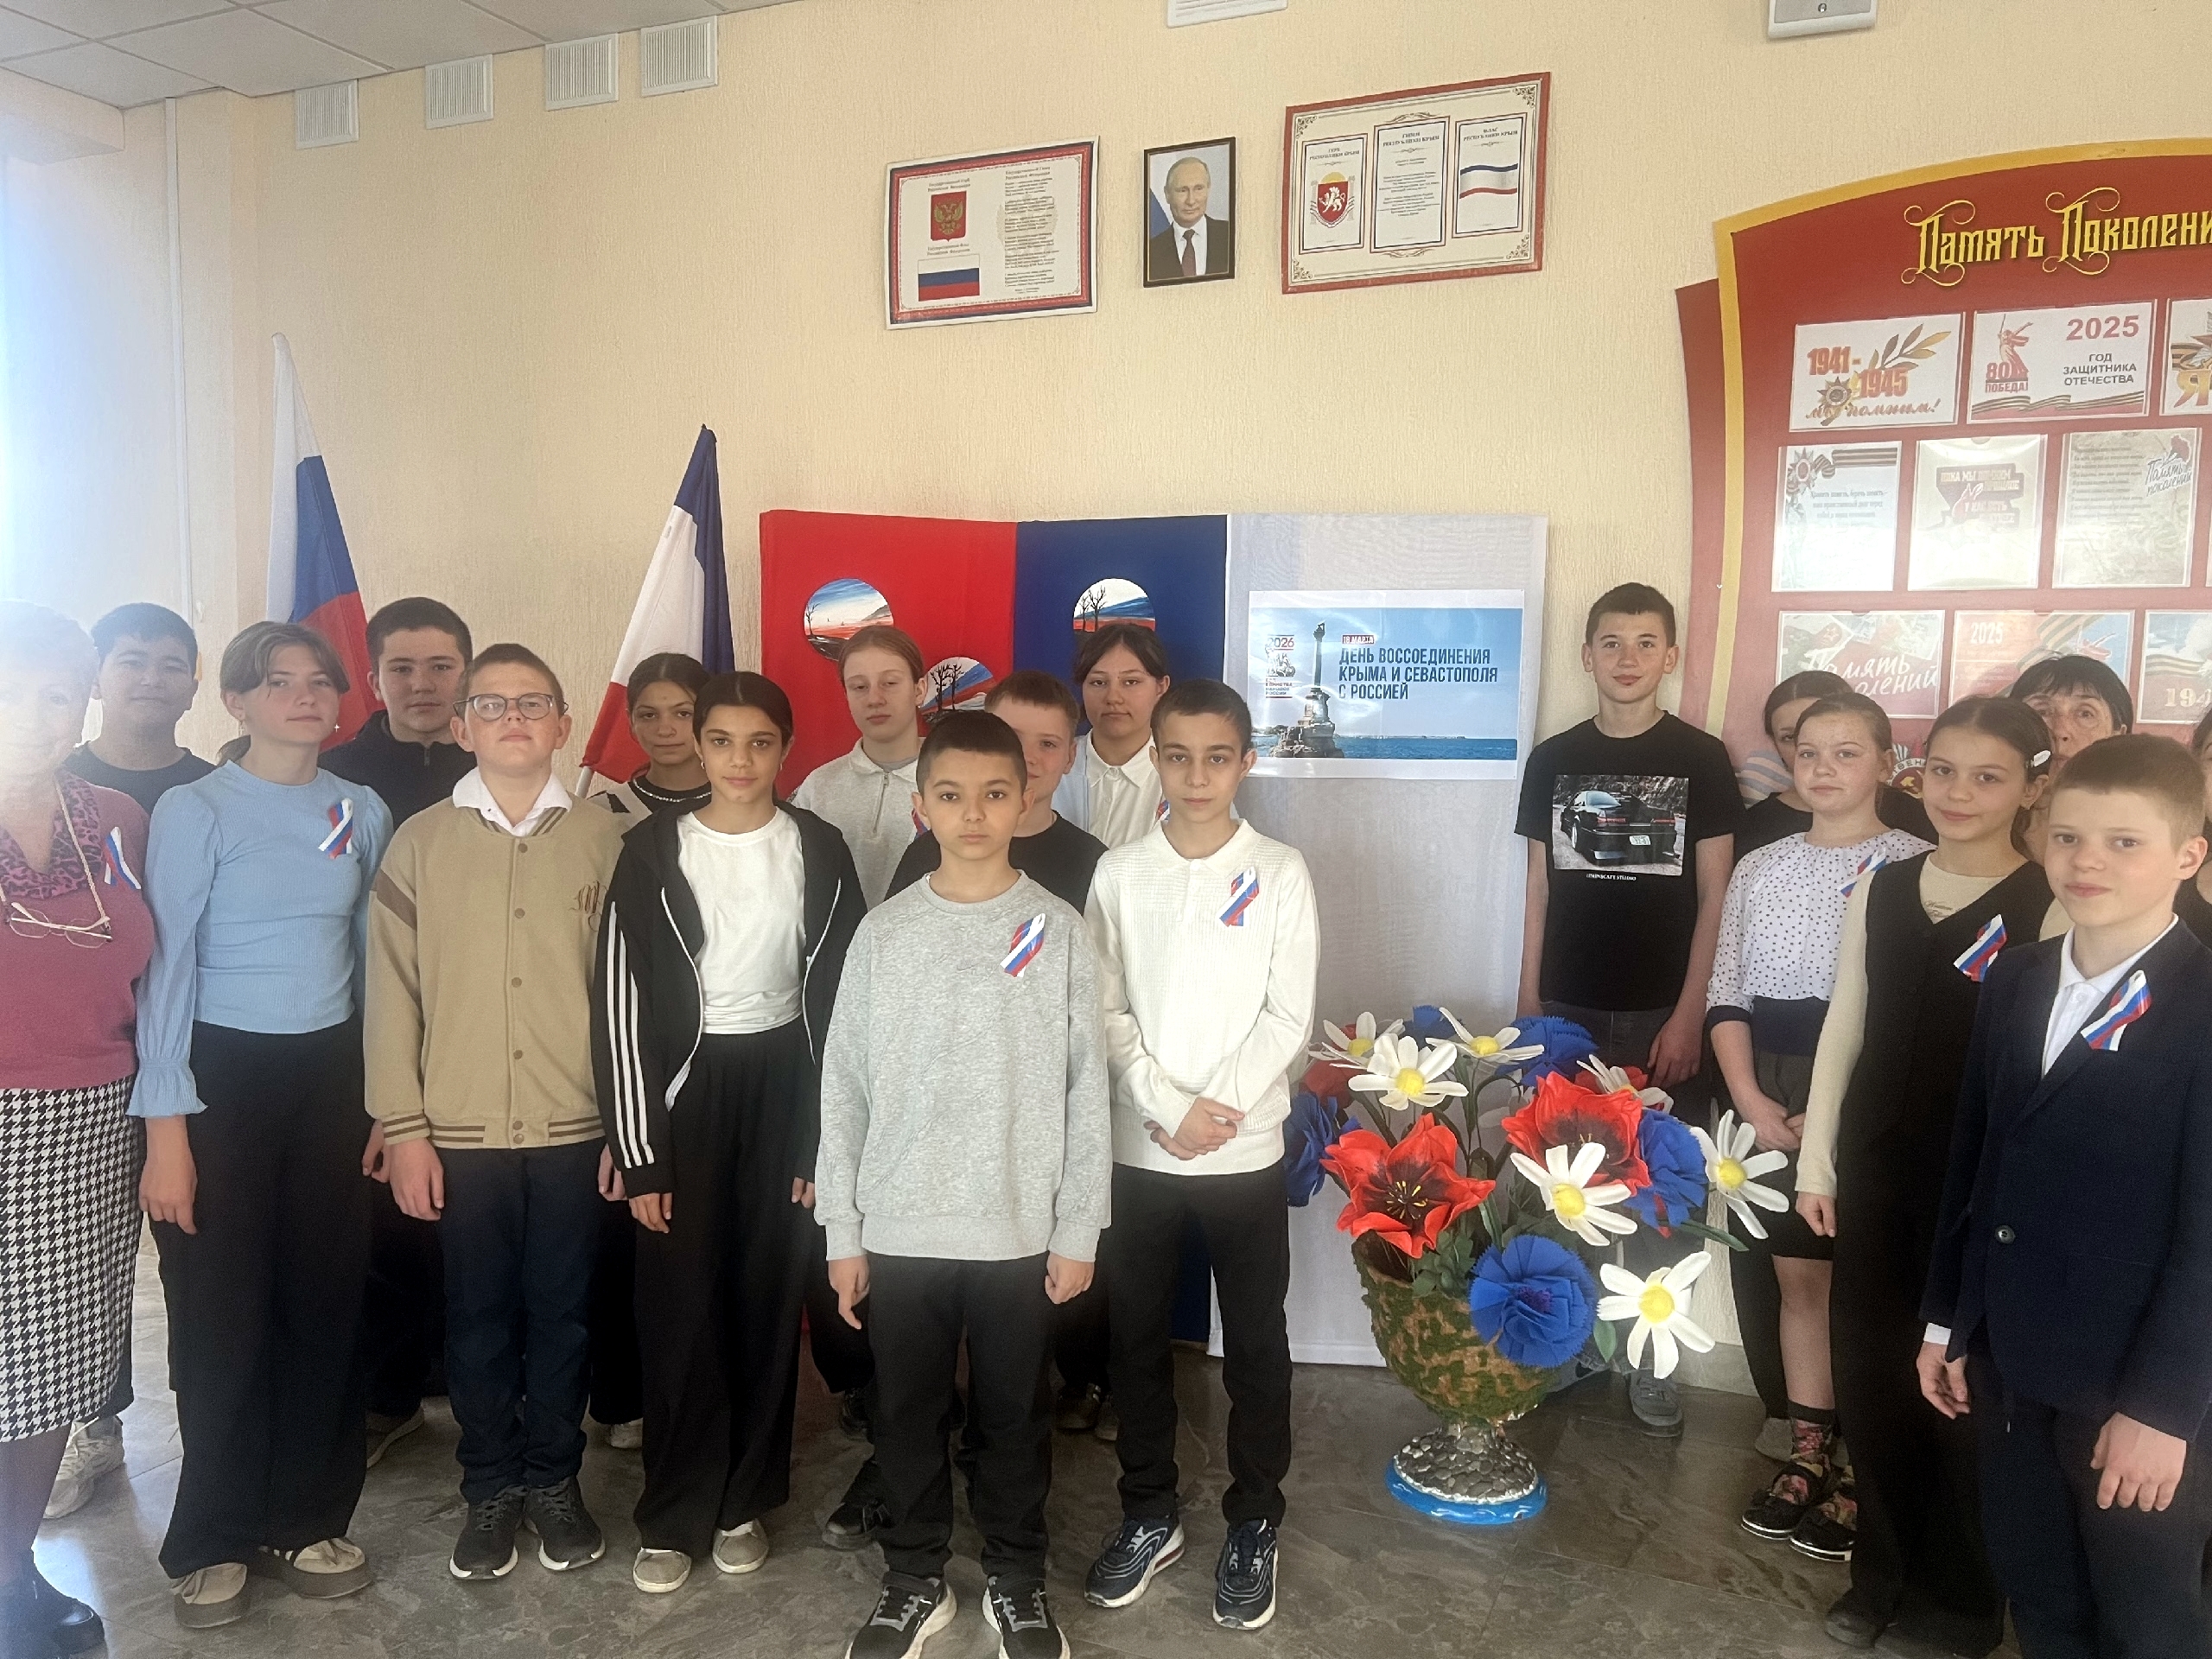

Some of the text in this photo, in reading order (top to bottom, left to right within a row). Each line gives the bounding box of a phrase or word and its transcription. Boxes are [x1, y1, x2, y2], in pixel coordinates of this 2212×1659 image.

[1901, 200, 2045, 286] Память
[2066, 315, 2140, 341] 2025
[2088, 353, 2113, 363] ГОД
[2063, 363, 2137, 375] ЗАЩИТНИКА
[1858, 367, 1910, 398] 1945
[2063, 374, 2134, 386] ОТЕЧЕСТВА
[2145, 458, 2183, 486] Память
[1267, 637, 1294, 648] 2026
[1969, 622, 2005, 645] 2025
[1338, 647, 1491, 665] ДЕНЬ ВОССОЕДИНЕНИЯ
[1338, 665, 1498, 683] КРЫМА И СЕВАСТОПОЛЯ
[1854, 665, 1939, 696] олений
[1338, 681, 1408, 700] С РОССИЕЙ
